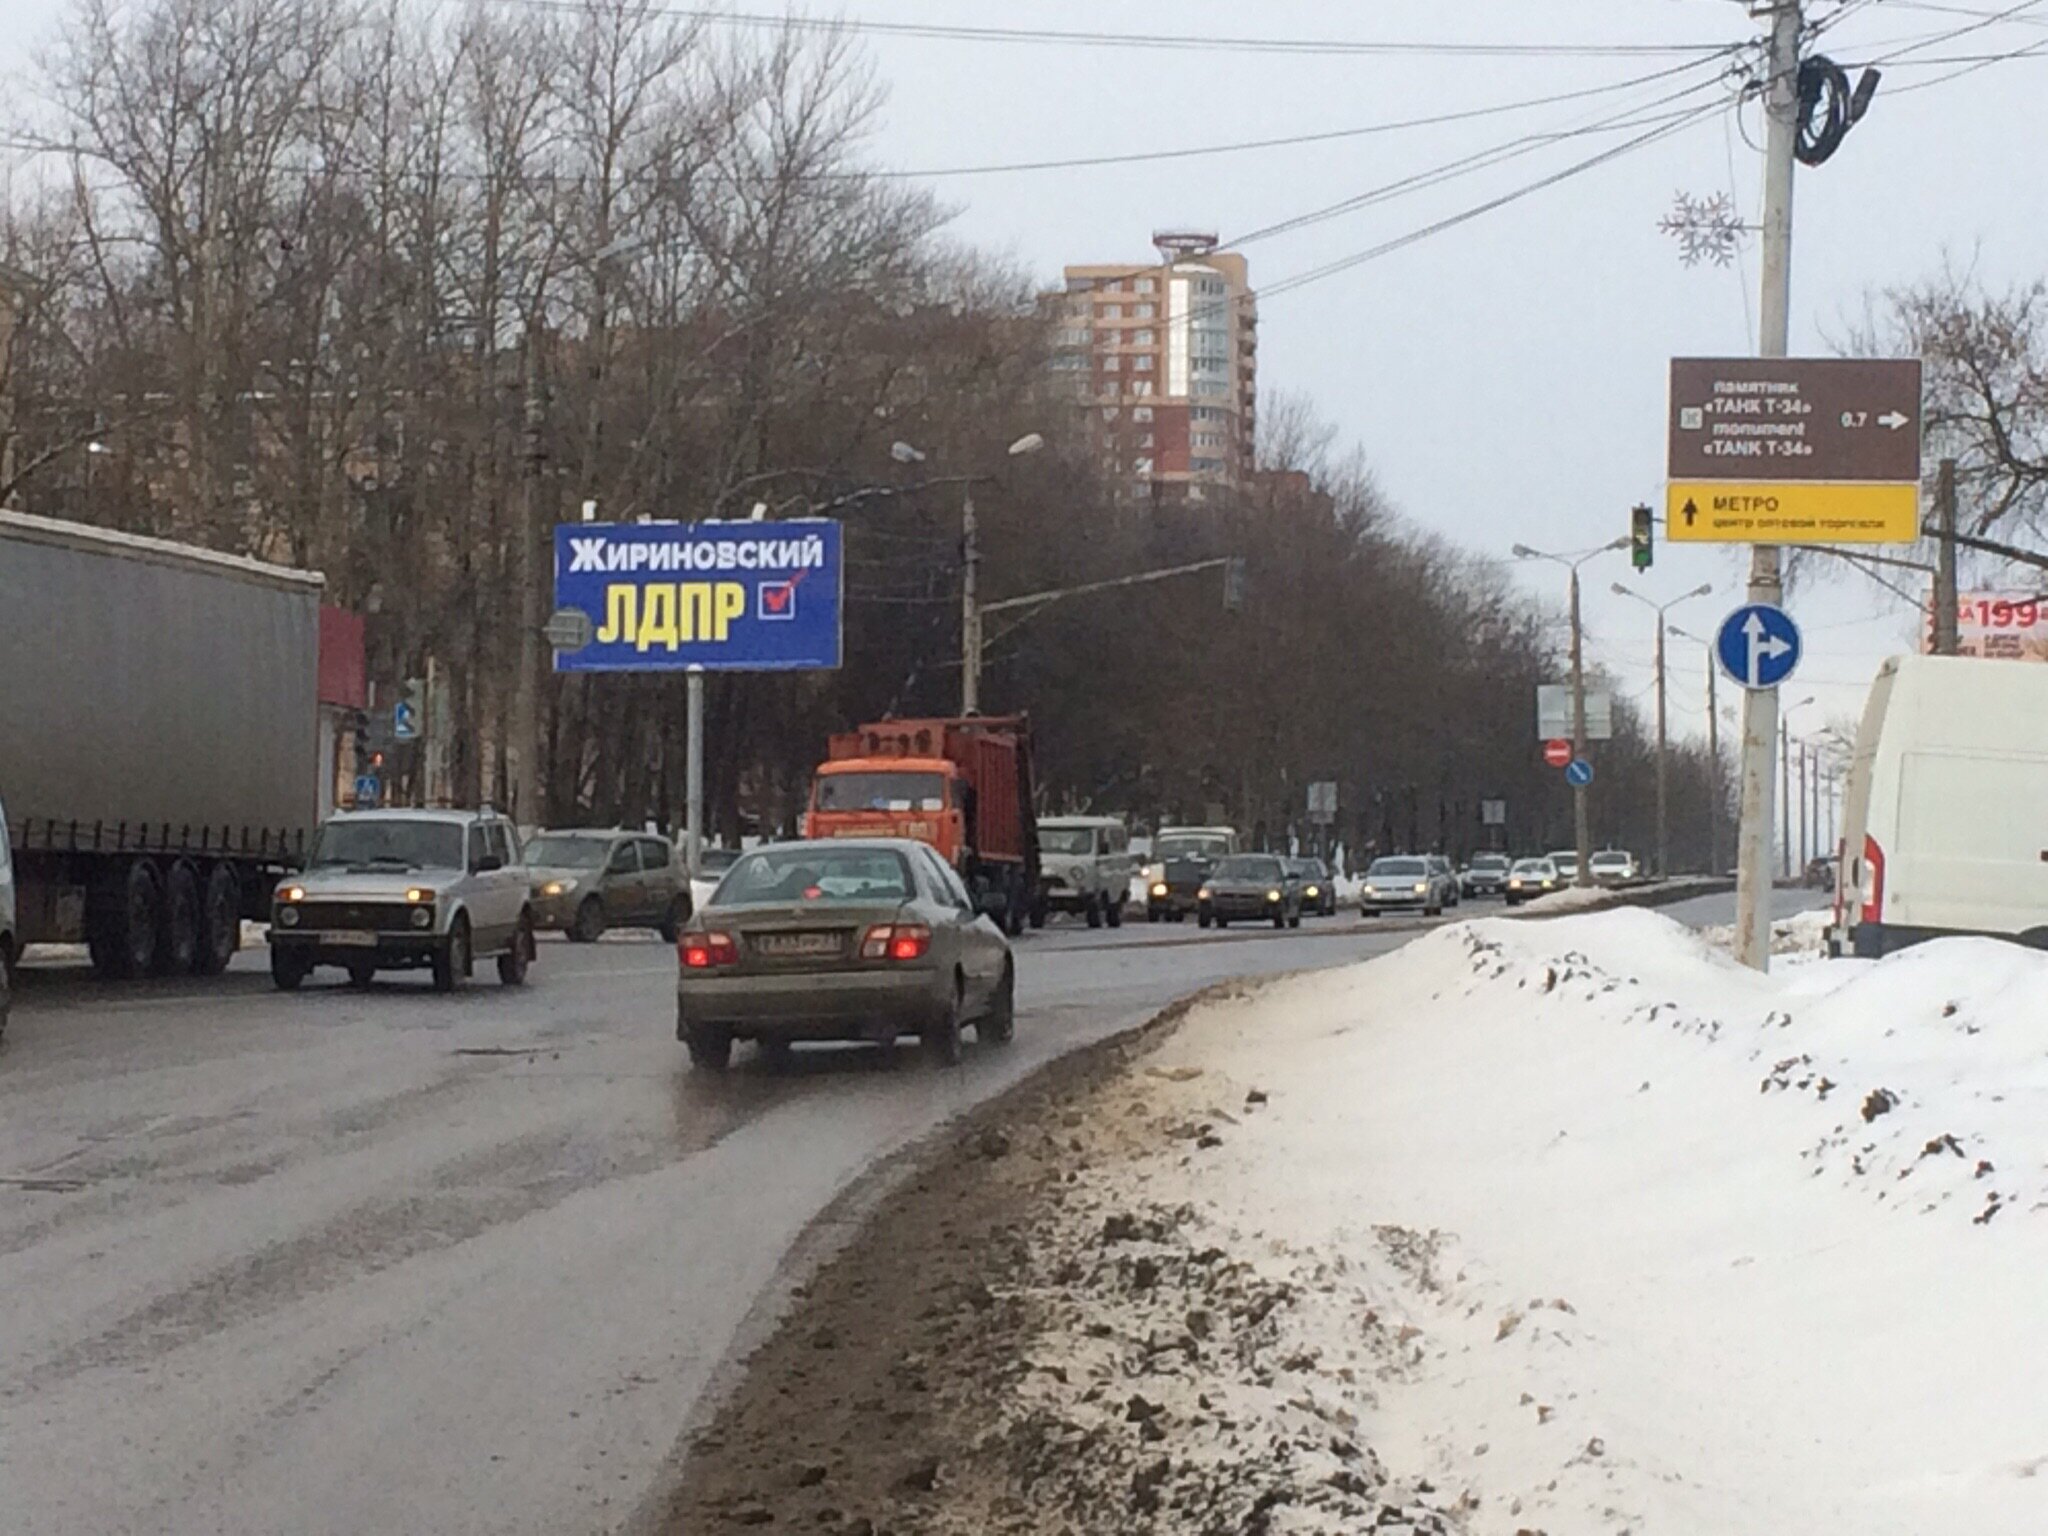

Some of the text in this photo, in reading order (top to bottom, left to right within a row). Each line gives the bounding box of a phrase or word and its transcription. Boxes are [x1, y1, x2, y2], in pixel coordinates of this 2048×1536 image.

[1713, 381, 1799, 395] памятник
[1713, 421, 1805, 436] monument
[1713, 496, 1779, 512] МЕТРО
[597, 582, 745, 652] ЛДПР
[1976, 599, 2038, 628] 199
